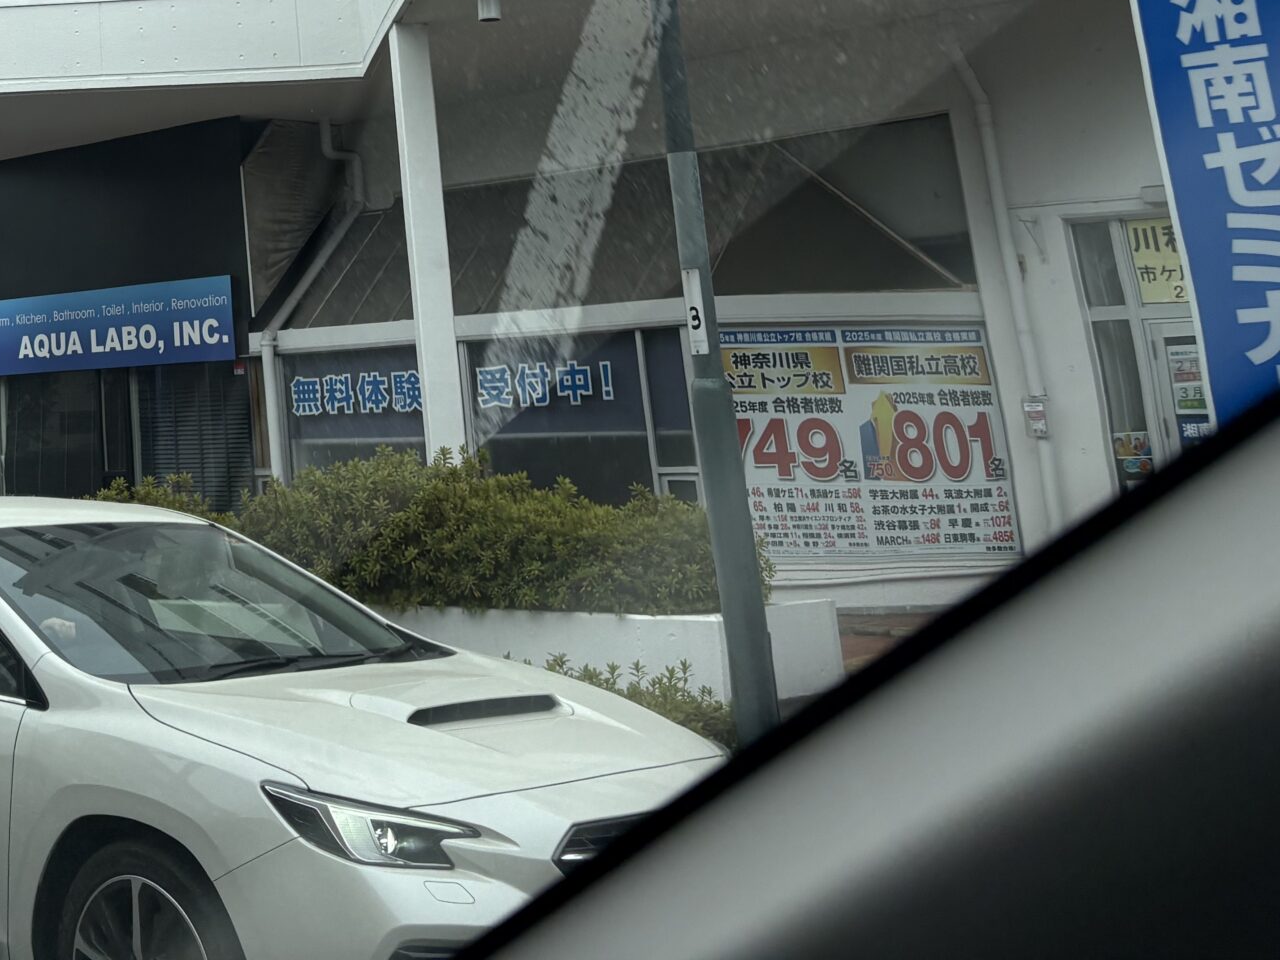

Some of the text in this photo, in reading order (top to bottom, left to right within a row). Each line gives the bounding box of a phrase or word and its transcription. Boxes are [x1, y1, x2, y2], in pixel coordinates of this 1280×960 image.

[16, 312, 47, 325] Kitchen
[53, 308, 95, 321] Bathroom
[102, 303, 125, 316] Toilet
[132, 300, 164, 314] Interior
[171, 294, 228, 310] Renovation
[689, 306, 701, 330] 3
[18, 318, 229, 359] AQUA LABO, INC.
[730, 351, 811, 370] 神奈川県
[853, 353, 980, 377] 難関国私立高校
[289, 370, 422, 417] 無料体験
[771, 395, 844, 415] 合格者総数
[892, 388, 994, 407] 2025年度 合格者総数
